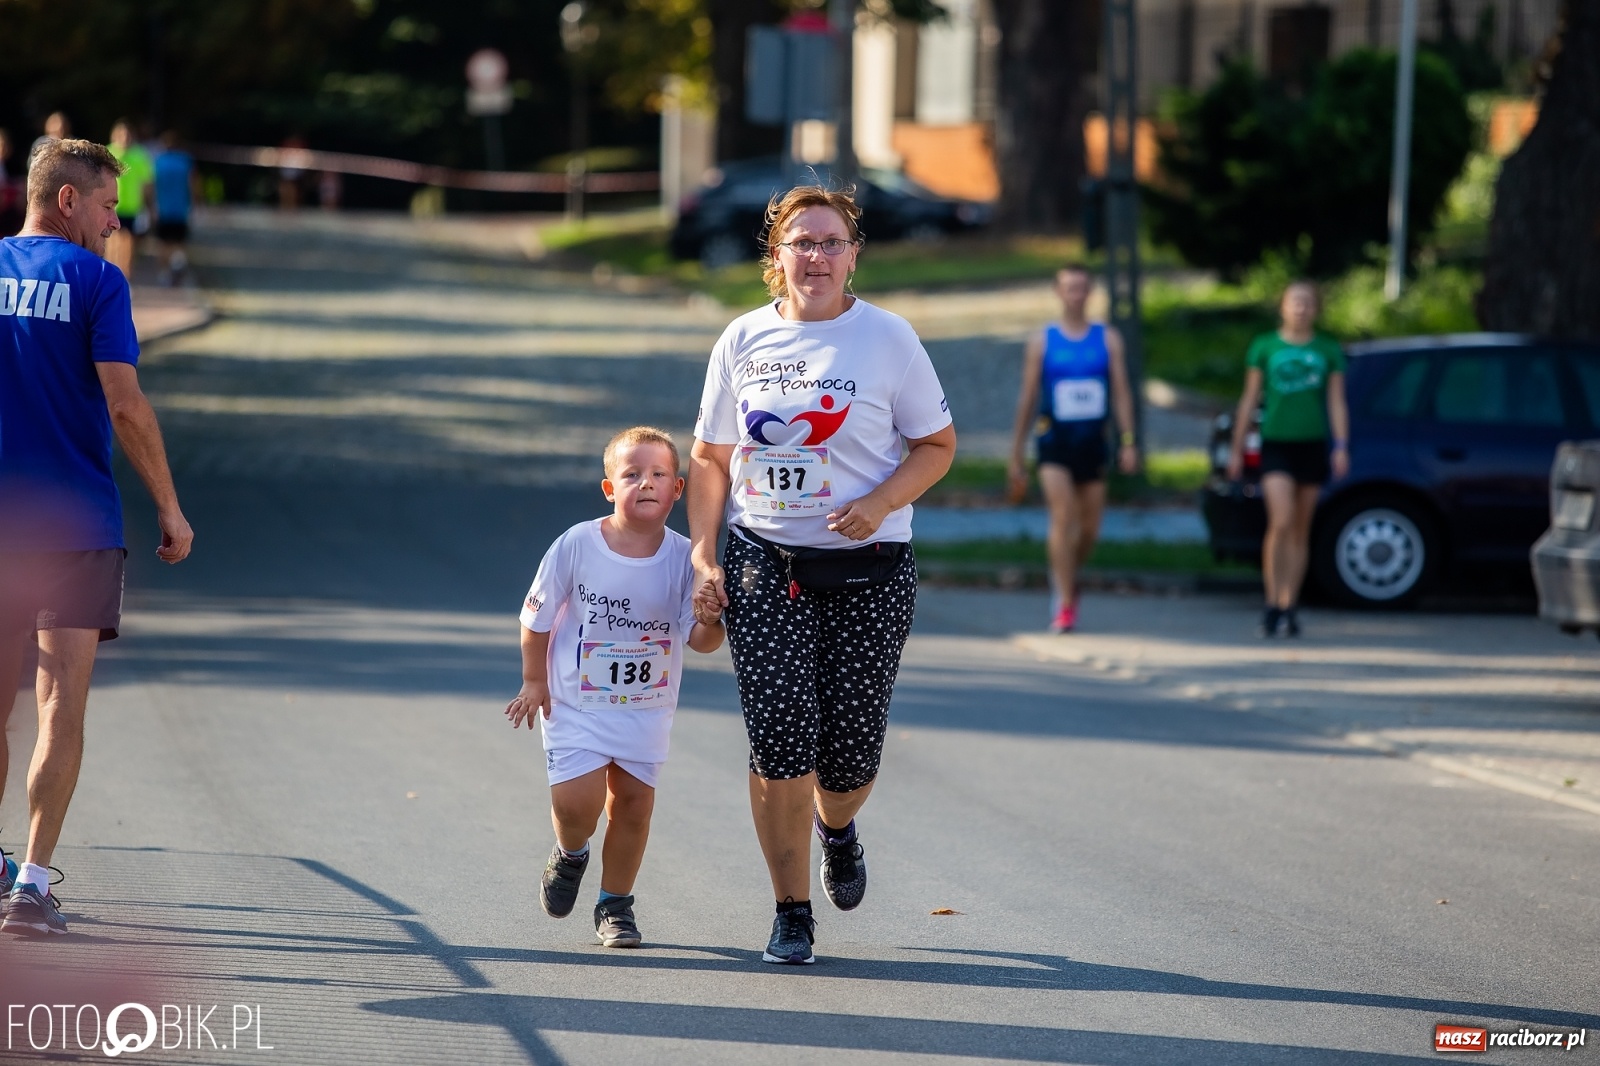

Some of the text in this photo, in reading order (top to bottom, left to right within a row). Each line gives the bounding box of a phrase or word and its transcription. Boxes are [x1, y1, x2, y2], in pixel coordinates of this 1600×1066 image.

[0, 277, 71, 323] DZIA
[746, 360, 808, 385] Biegnę
[759, 378, 856, 397] z pomocą
[766, 466, 807, 491] 137
[578, 583, 631, 618] Biegnę
[588, 610, 671, 635] z pomocą
[608, 660, 652, 685] 138
